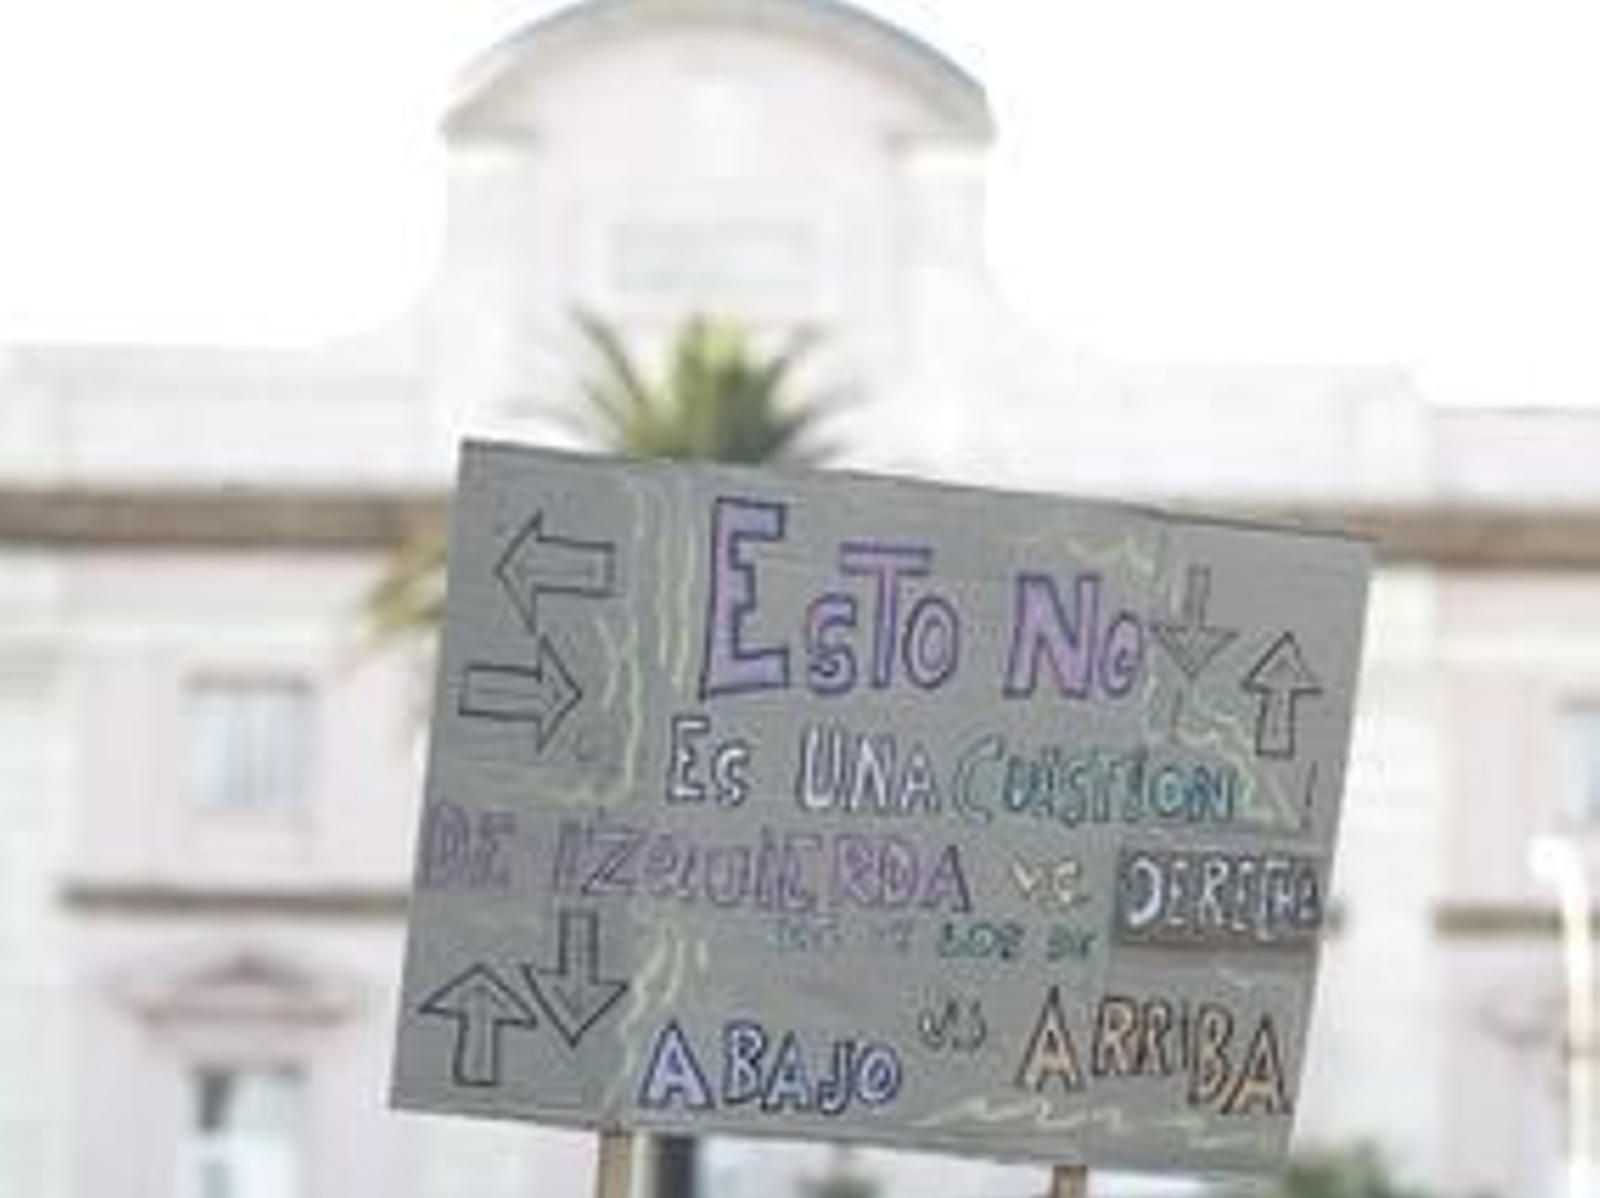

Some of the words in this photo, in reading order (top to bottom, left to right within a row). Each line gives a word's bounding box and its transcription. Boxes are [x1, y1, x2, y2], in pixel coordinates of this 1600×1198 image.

[797, 722, 942, 816] UNA
[637, 1018, 902, 1116] ABAJO
[1013, 984, 1294, 1118] ARRIBA
